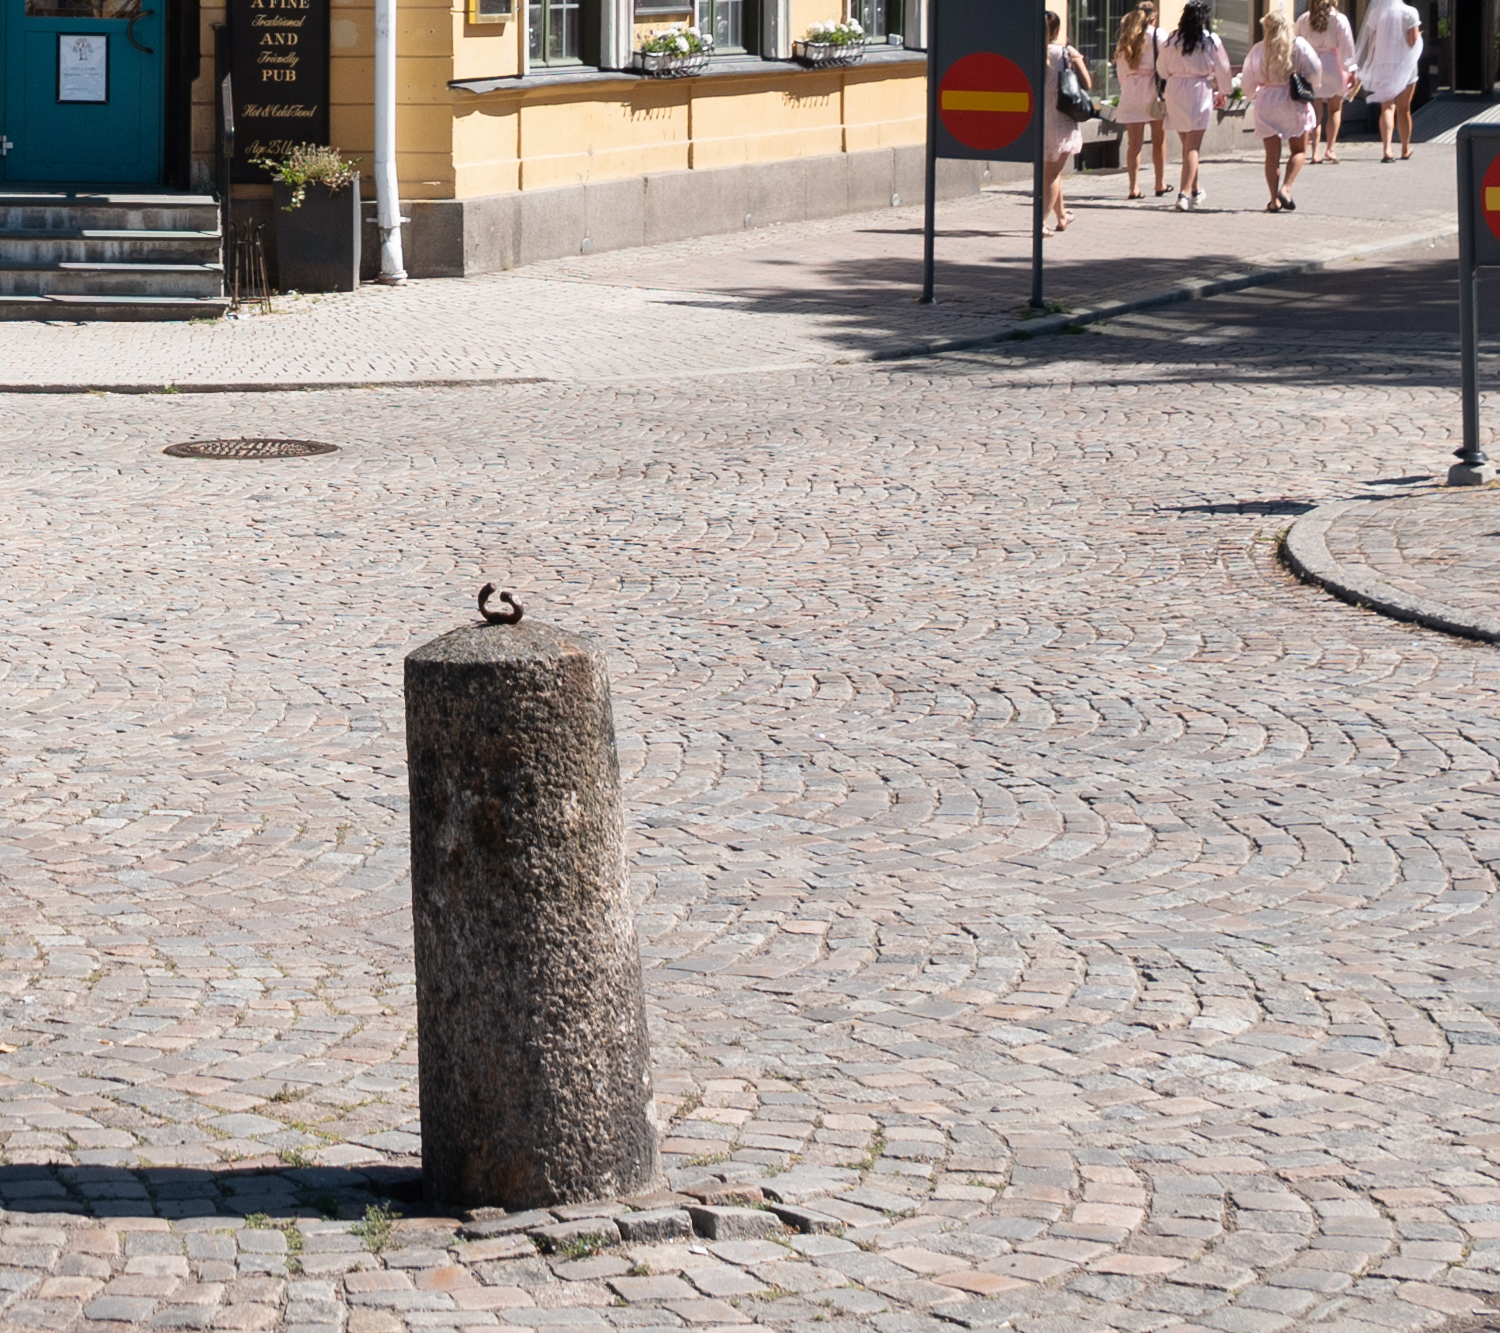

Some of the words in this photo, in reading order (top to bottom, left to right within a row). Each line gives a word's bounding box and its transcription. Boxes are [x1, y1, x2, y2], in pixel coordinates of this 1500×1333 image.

[251, 14, 307, 27] Traditional
[259, 32, 298, 45] AND
[261, 69, 297, 82] PUB
